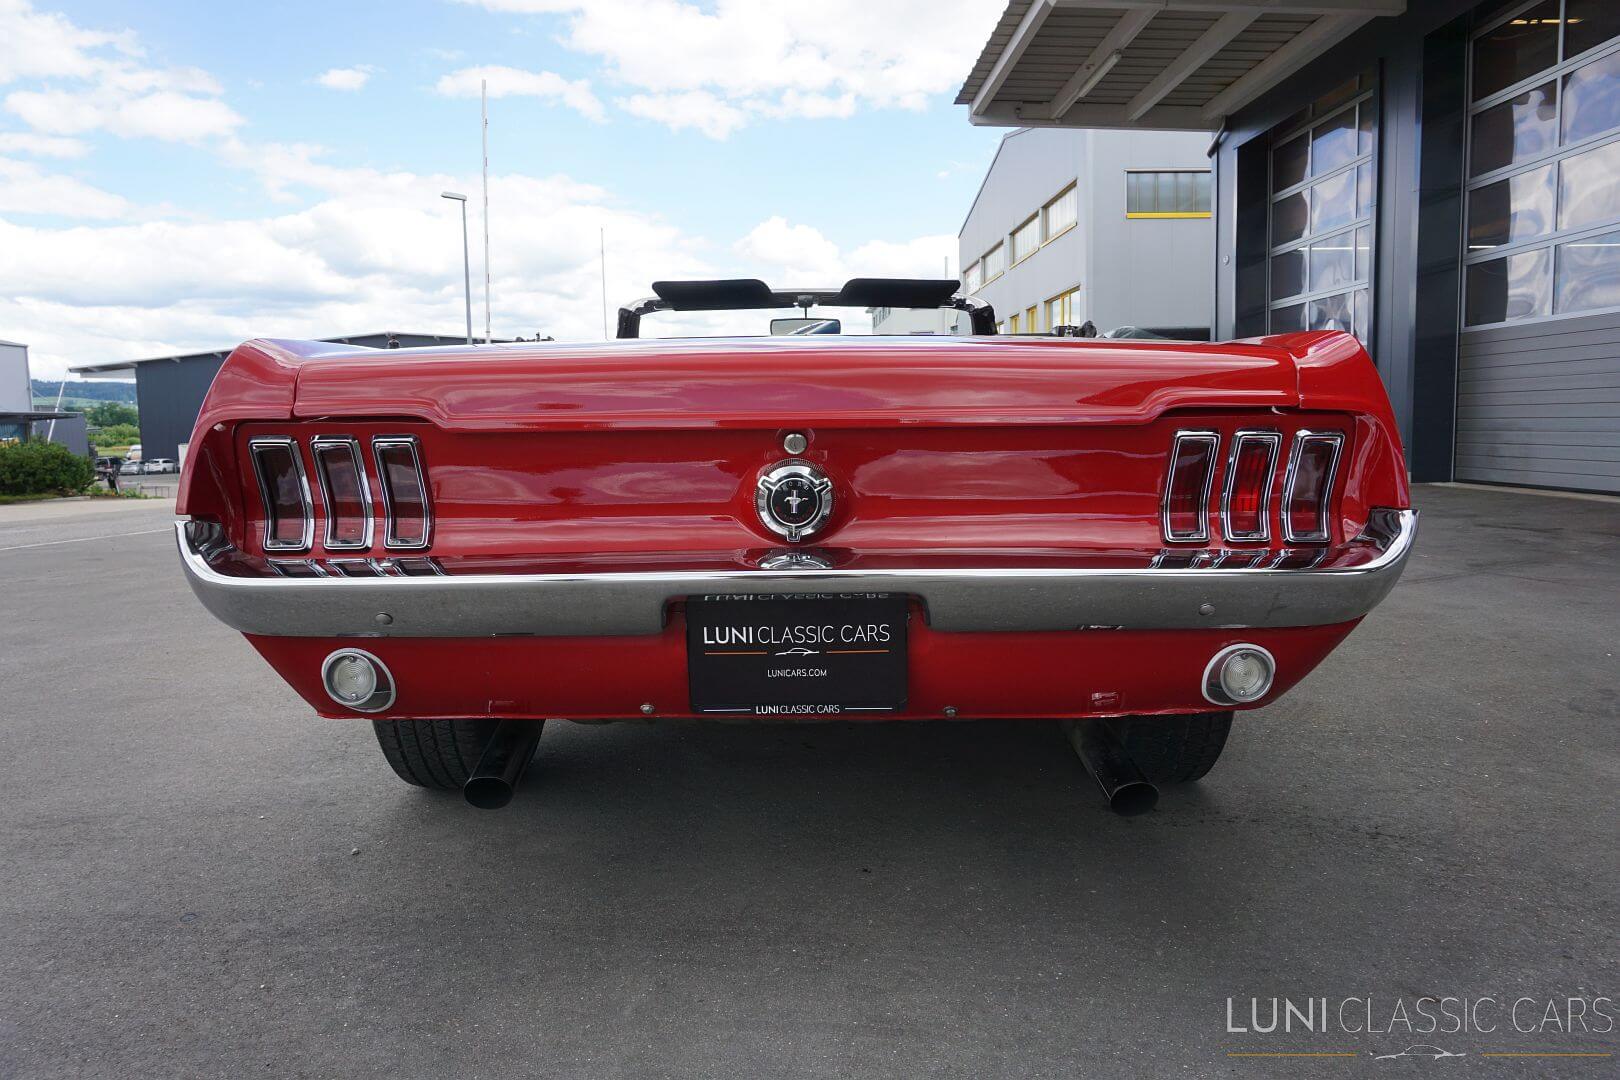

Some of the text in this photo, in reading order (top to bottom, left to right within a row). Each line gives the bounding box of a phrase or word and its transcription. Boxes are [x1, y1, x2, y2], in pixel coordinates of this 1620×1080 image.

[703, 624, 891, 644] LUNI CLASSIC CARS
[767, 668, 827, 678] LUNICARS.COM
[755, 704, 840, 715] LUNI CLASSIC CARS
